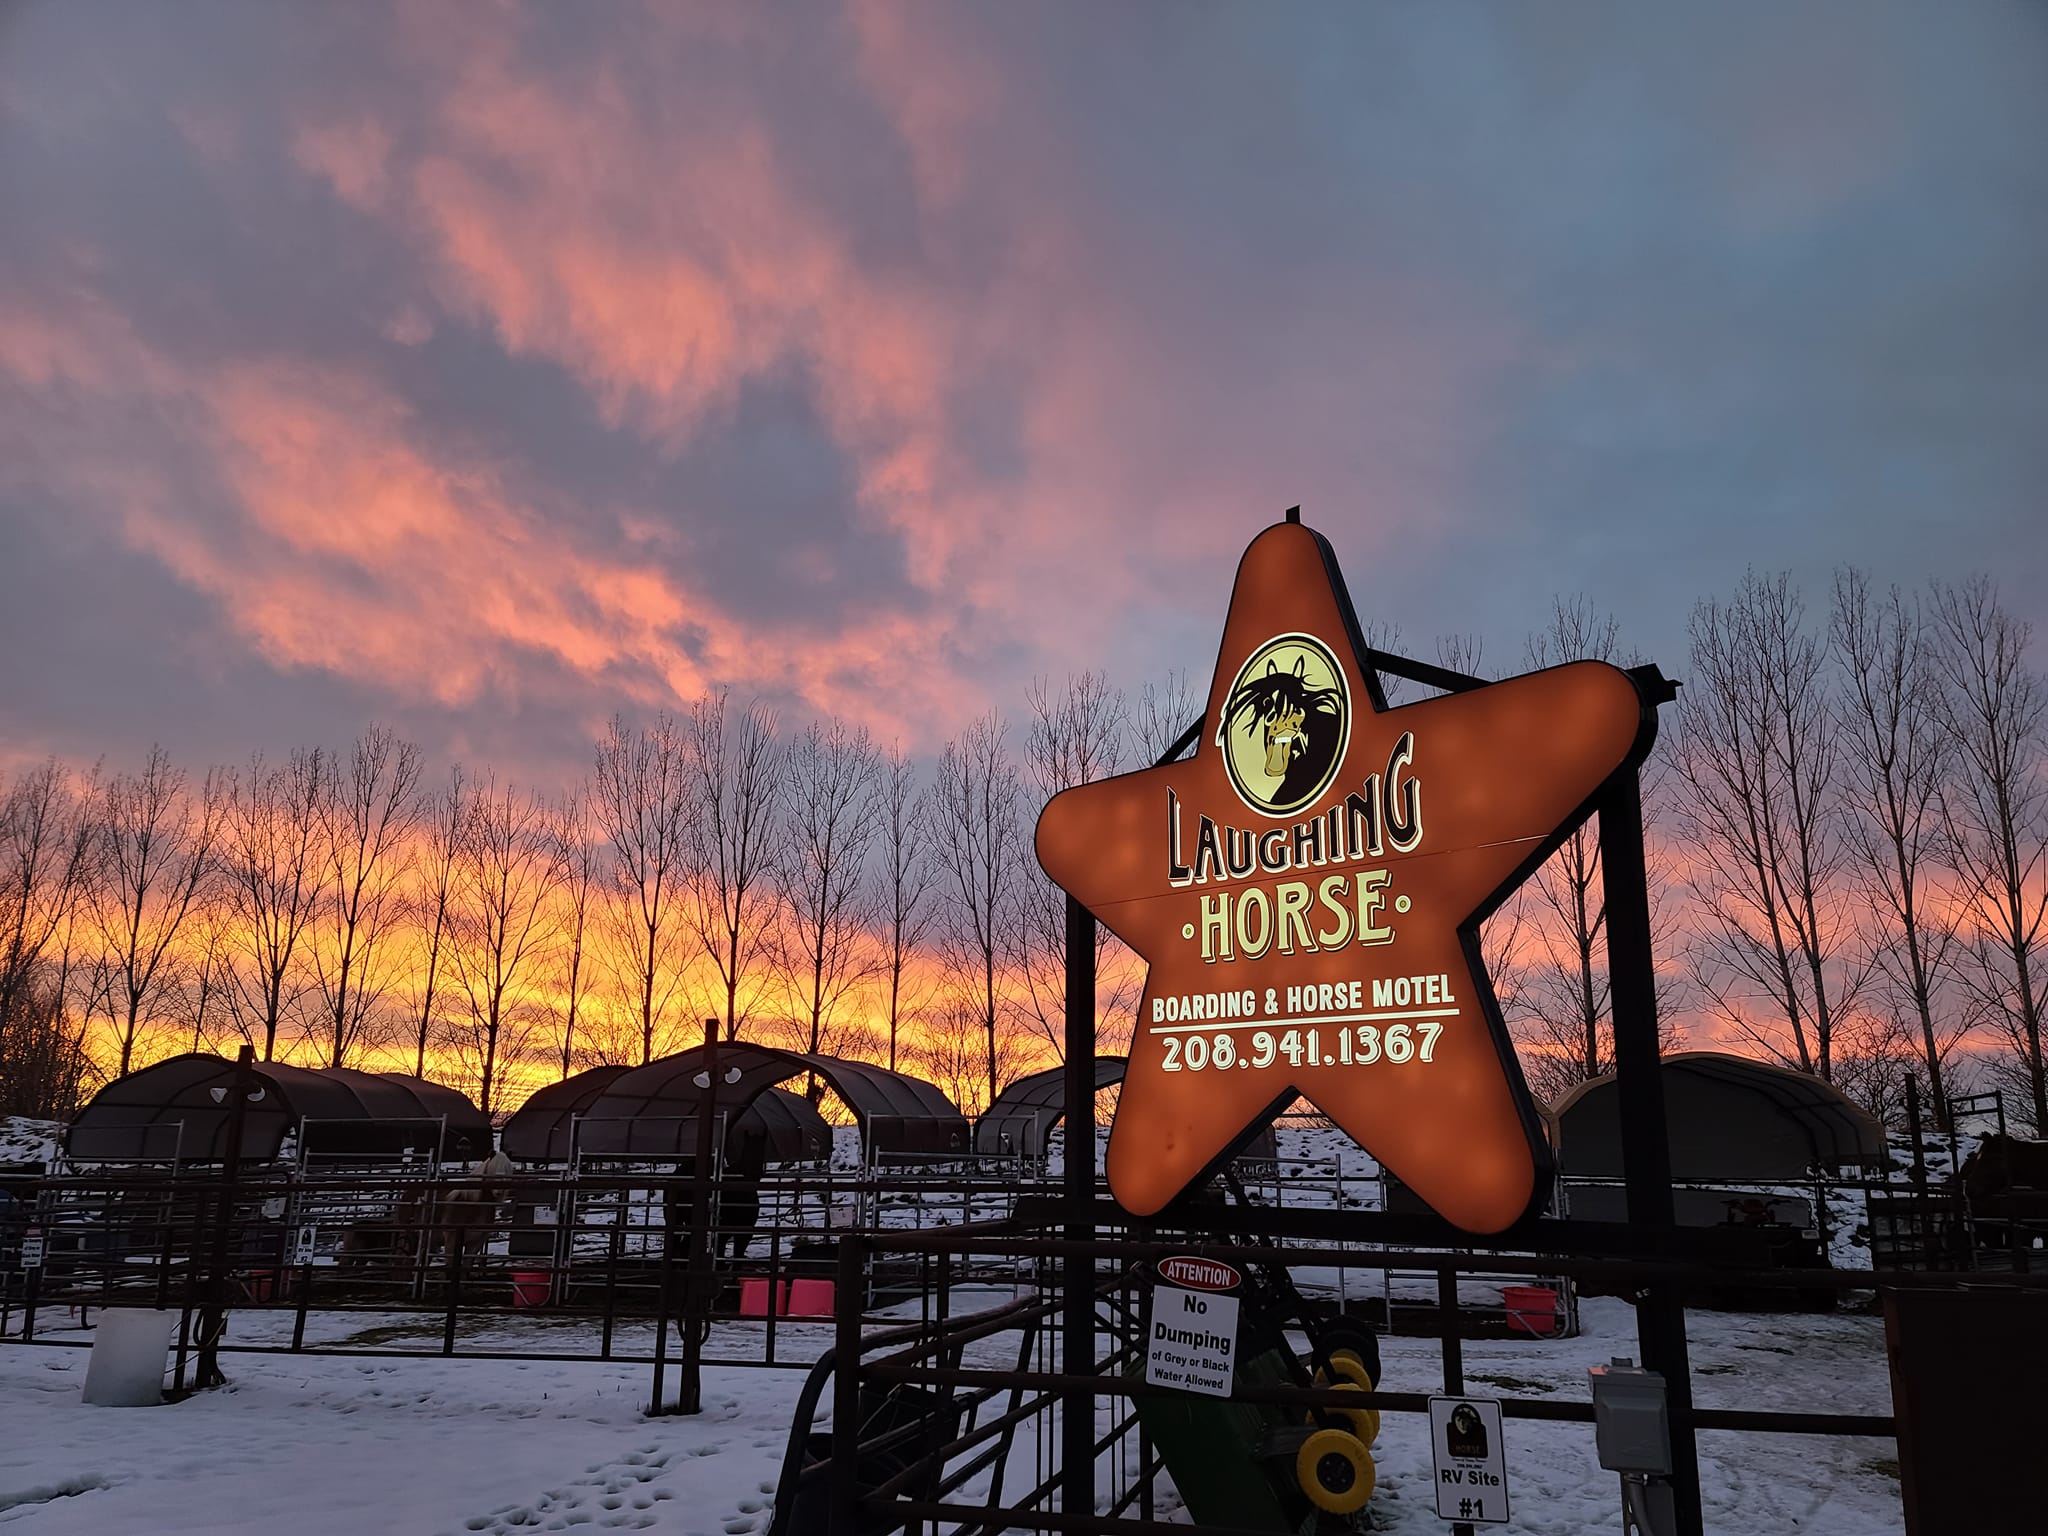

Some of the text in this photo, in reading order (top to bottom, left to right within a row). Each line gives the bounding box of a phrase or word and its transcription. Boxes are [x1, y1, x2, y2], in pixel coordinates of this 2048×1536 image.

[1167, 731, 1422, 887] LAUGHING
[1200, 869, 1395, 963] HORSE
[1152, 974, 1455, 1023] BOARDING & HORSE MOTEL
[1161, 1022, 1443, 1072] 208.941.1367
[1166, 1261, 1231, 1286] ATTENTION
[1184, 1294, 1208, 1315] No
[1154, 1322, 1231, 1355] Dumping
[1152, 1351, 1230, 1372] of Grey or Black
[1154, 1368, 1223, 1389] Water Allowed
[1441, 1469, 1500, 1486] RV Site
[1459, 1498, 1483, 1518] #1
